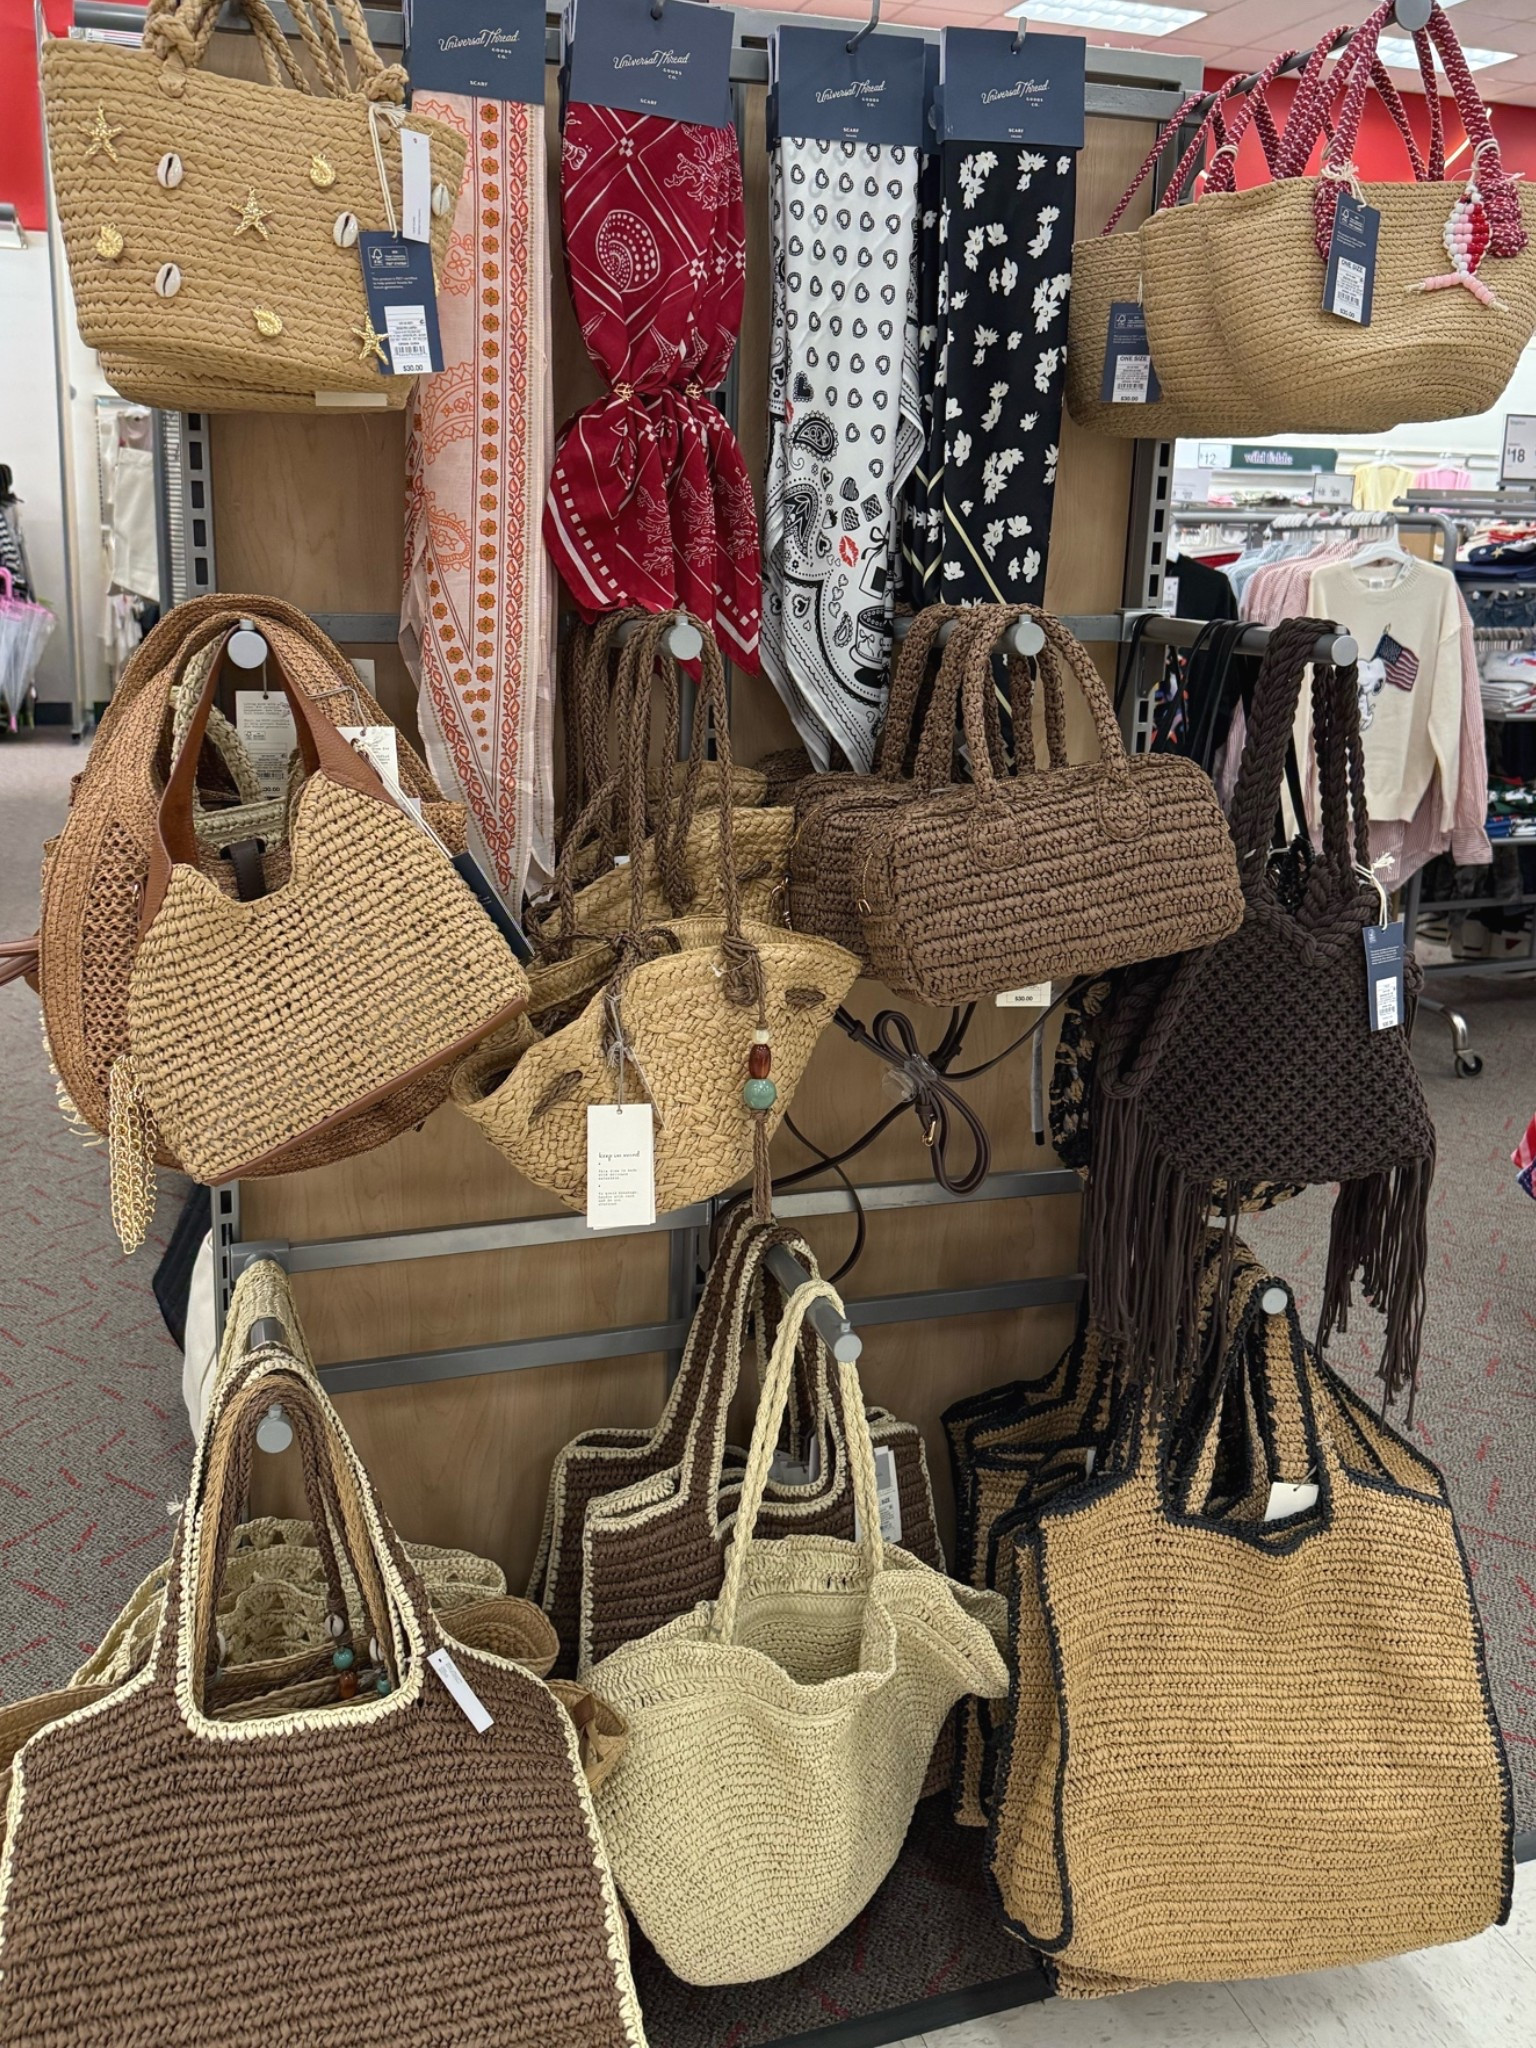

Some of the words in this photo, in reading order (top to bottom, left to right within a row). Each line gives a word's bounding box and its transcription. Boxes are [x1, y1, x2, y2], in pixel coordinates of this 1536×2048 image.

[438, 32, 485, 51] Universal
[479, 28, 520, 47] Thread
[613, 53, 658, 69] Universal
[652, 50, 691, 67] Thread
[816, 84, 856, 103] Universal
[851, 80, 886, 97] Thread
[981, 84, 1021, 104] Universal
[1016, 79, 1050, 97] Thread
[403, 364, 423, 373] $30.00
